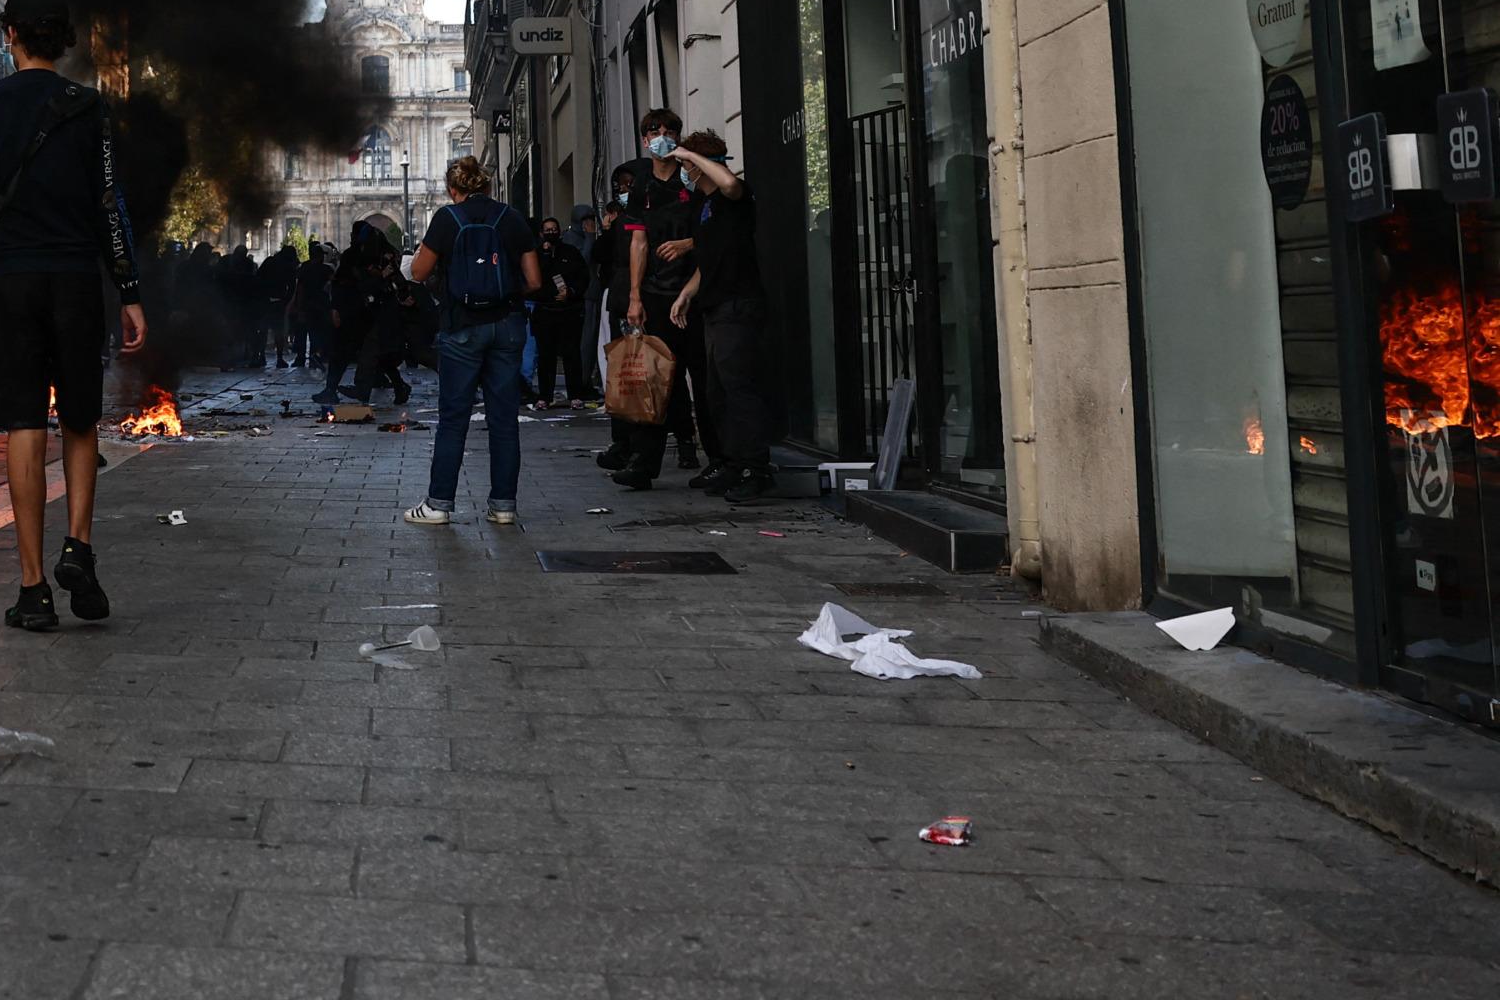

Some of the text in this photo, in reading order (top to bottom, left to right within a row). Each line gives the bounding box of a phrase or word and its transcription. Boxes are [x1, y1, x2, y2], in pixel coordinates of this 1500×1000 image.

[520, 28, 564, 42] undiz
[930, 11, 983, 67] CHABR
[1269, 101, 1300, 136] 20%
[108, 211, 124, 258] VERSACE
